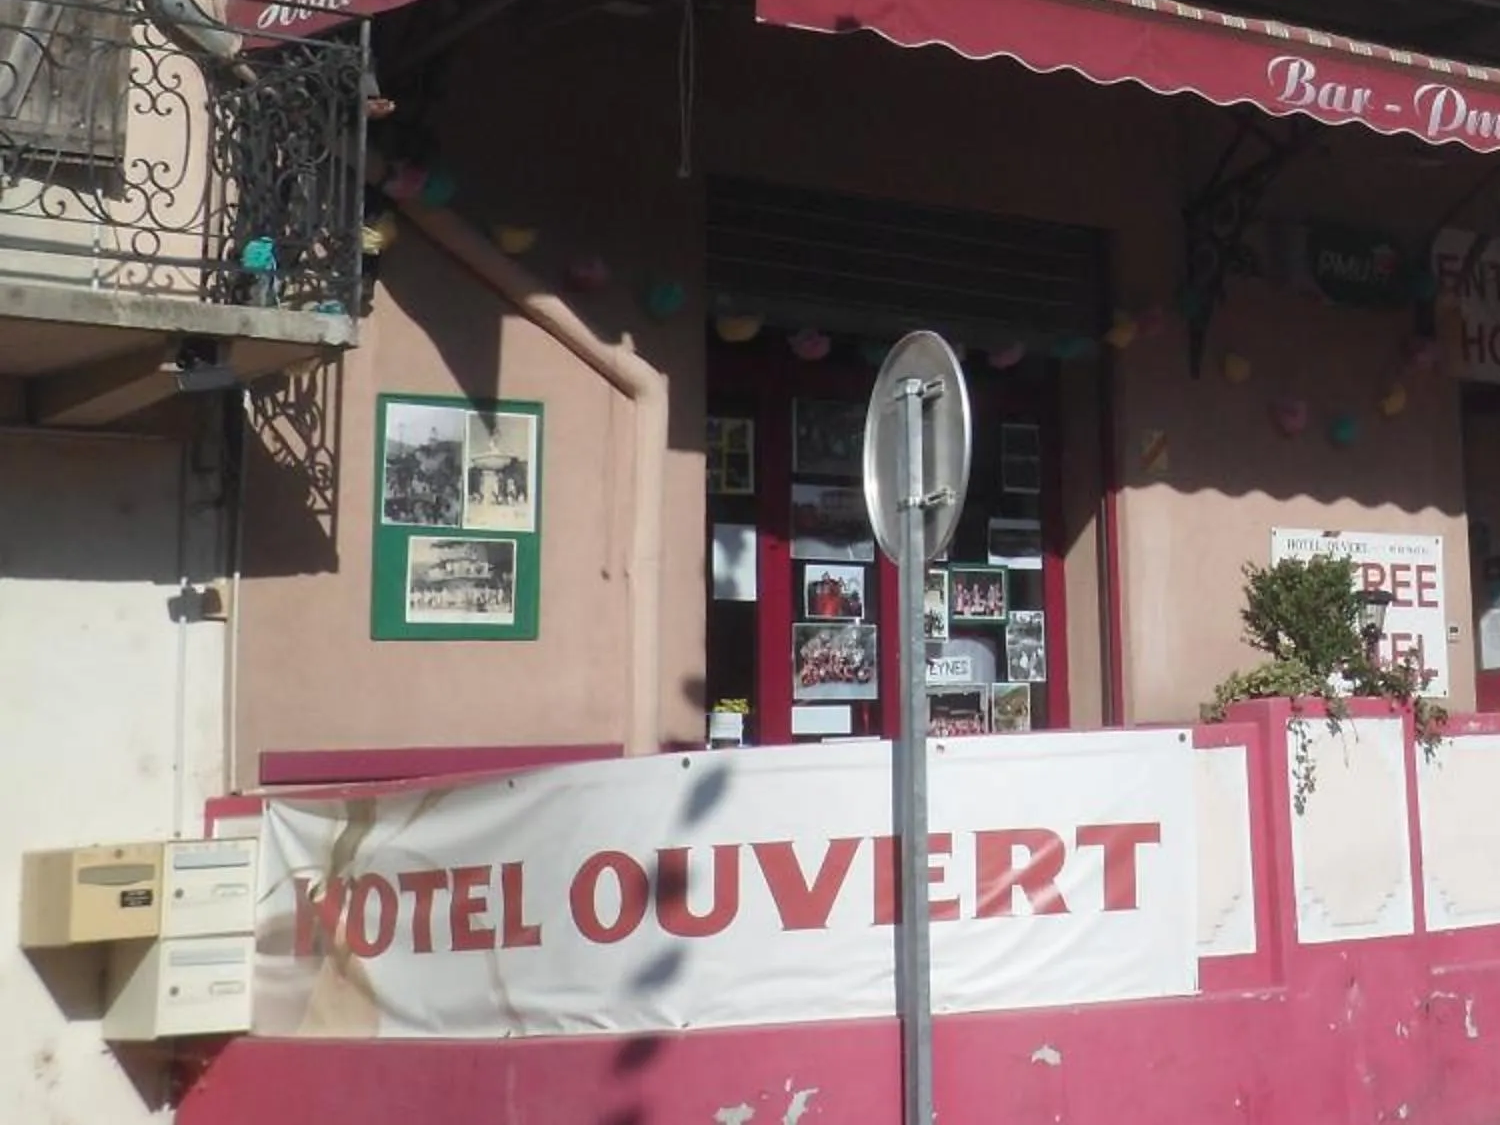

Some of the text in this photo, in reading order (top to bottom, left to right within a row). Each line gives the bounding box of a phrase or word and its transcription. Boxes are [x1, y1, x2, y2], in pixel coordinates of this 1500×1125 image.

[1267, 54, 1374, 115] Bar
[292, 820, 1162, 960] HOTEL OUVERT
